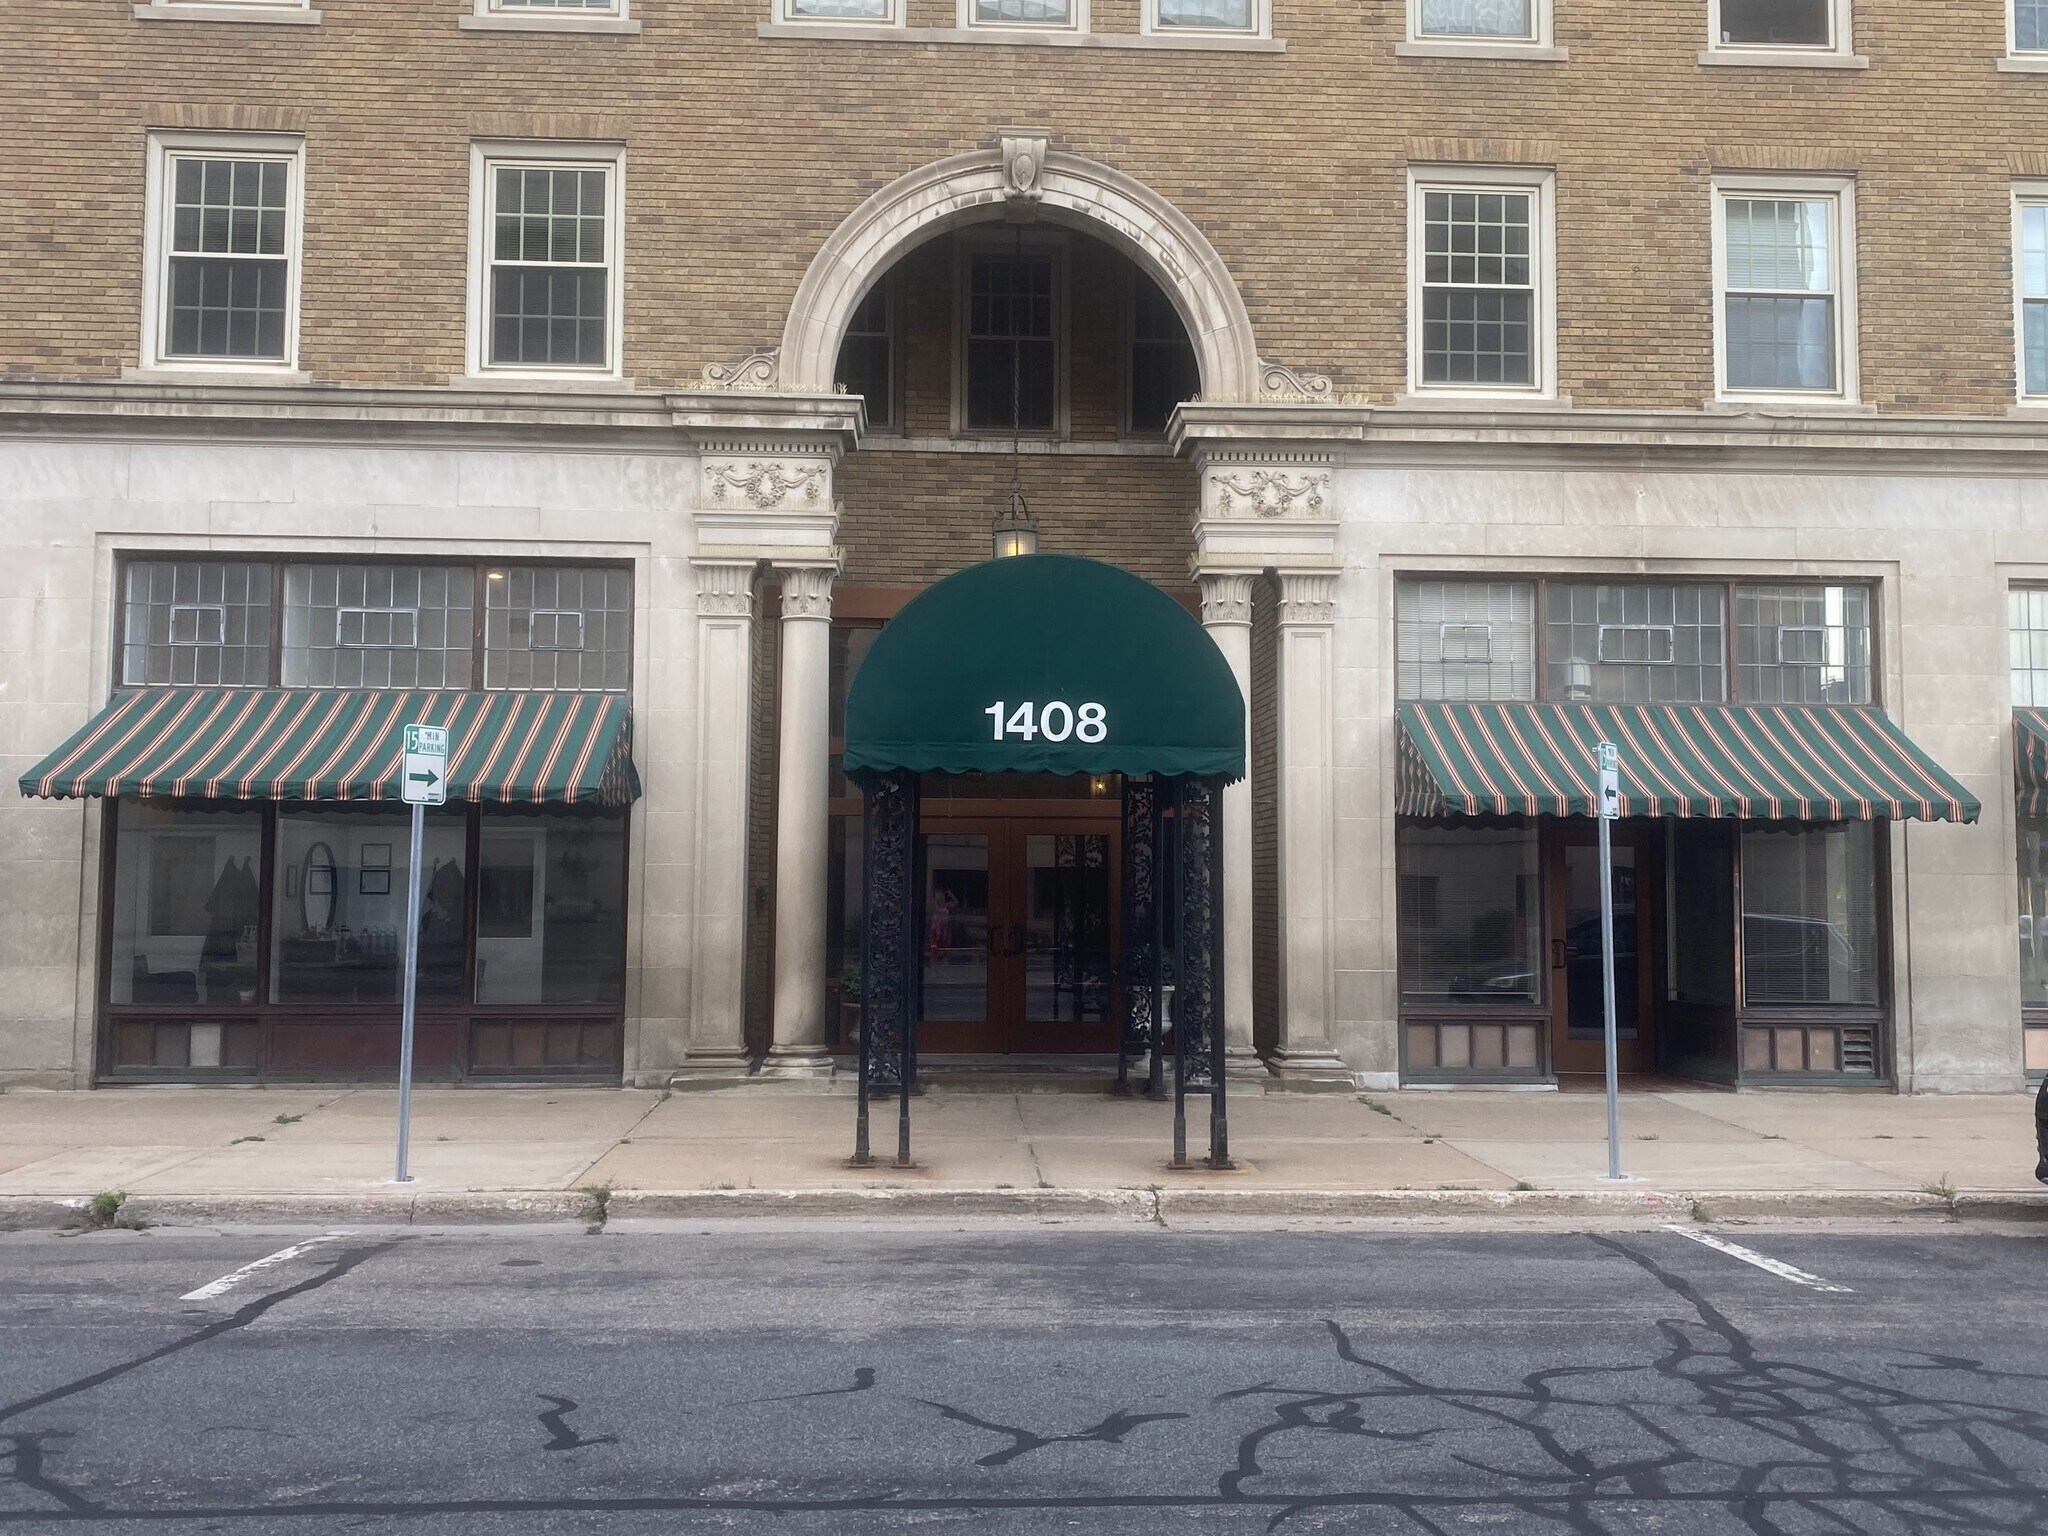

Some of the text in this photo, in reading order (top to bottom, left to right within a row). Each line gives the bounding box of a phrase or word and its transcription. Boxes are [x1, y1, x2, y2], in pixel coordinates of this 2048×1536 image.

[984, 700, 1108, 743] 1408
[407, 731, 418, 750] 15
[427, 731, 440, 741] MIN
[419, 742, 445, 754] PARKING
